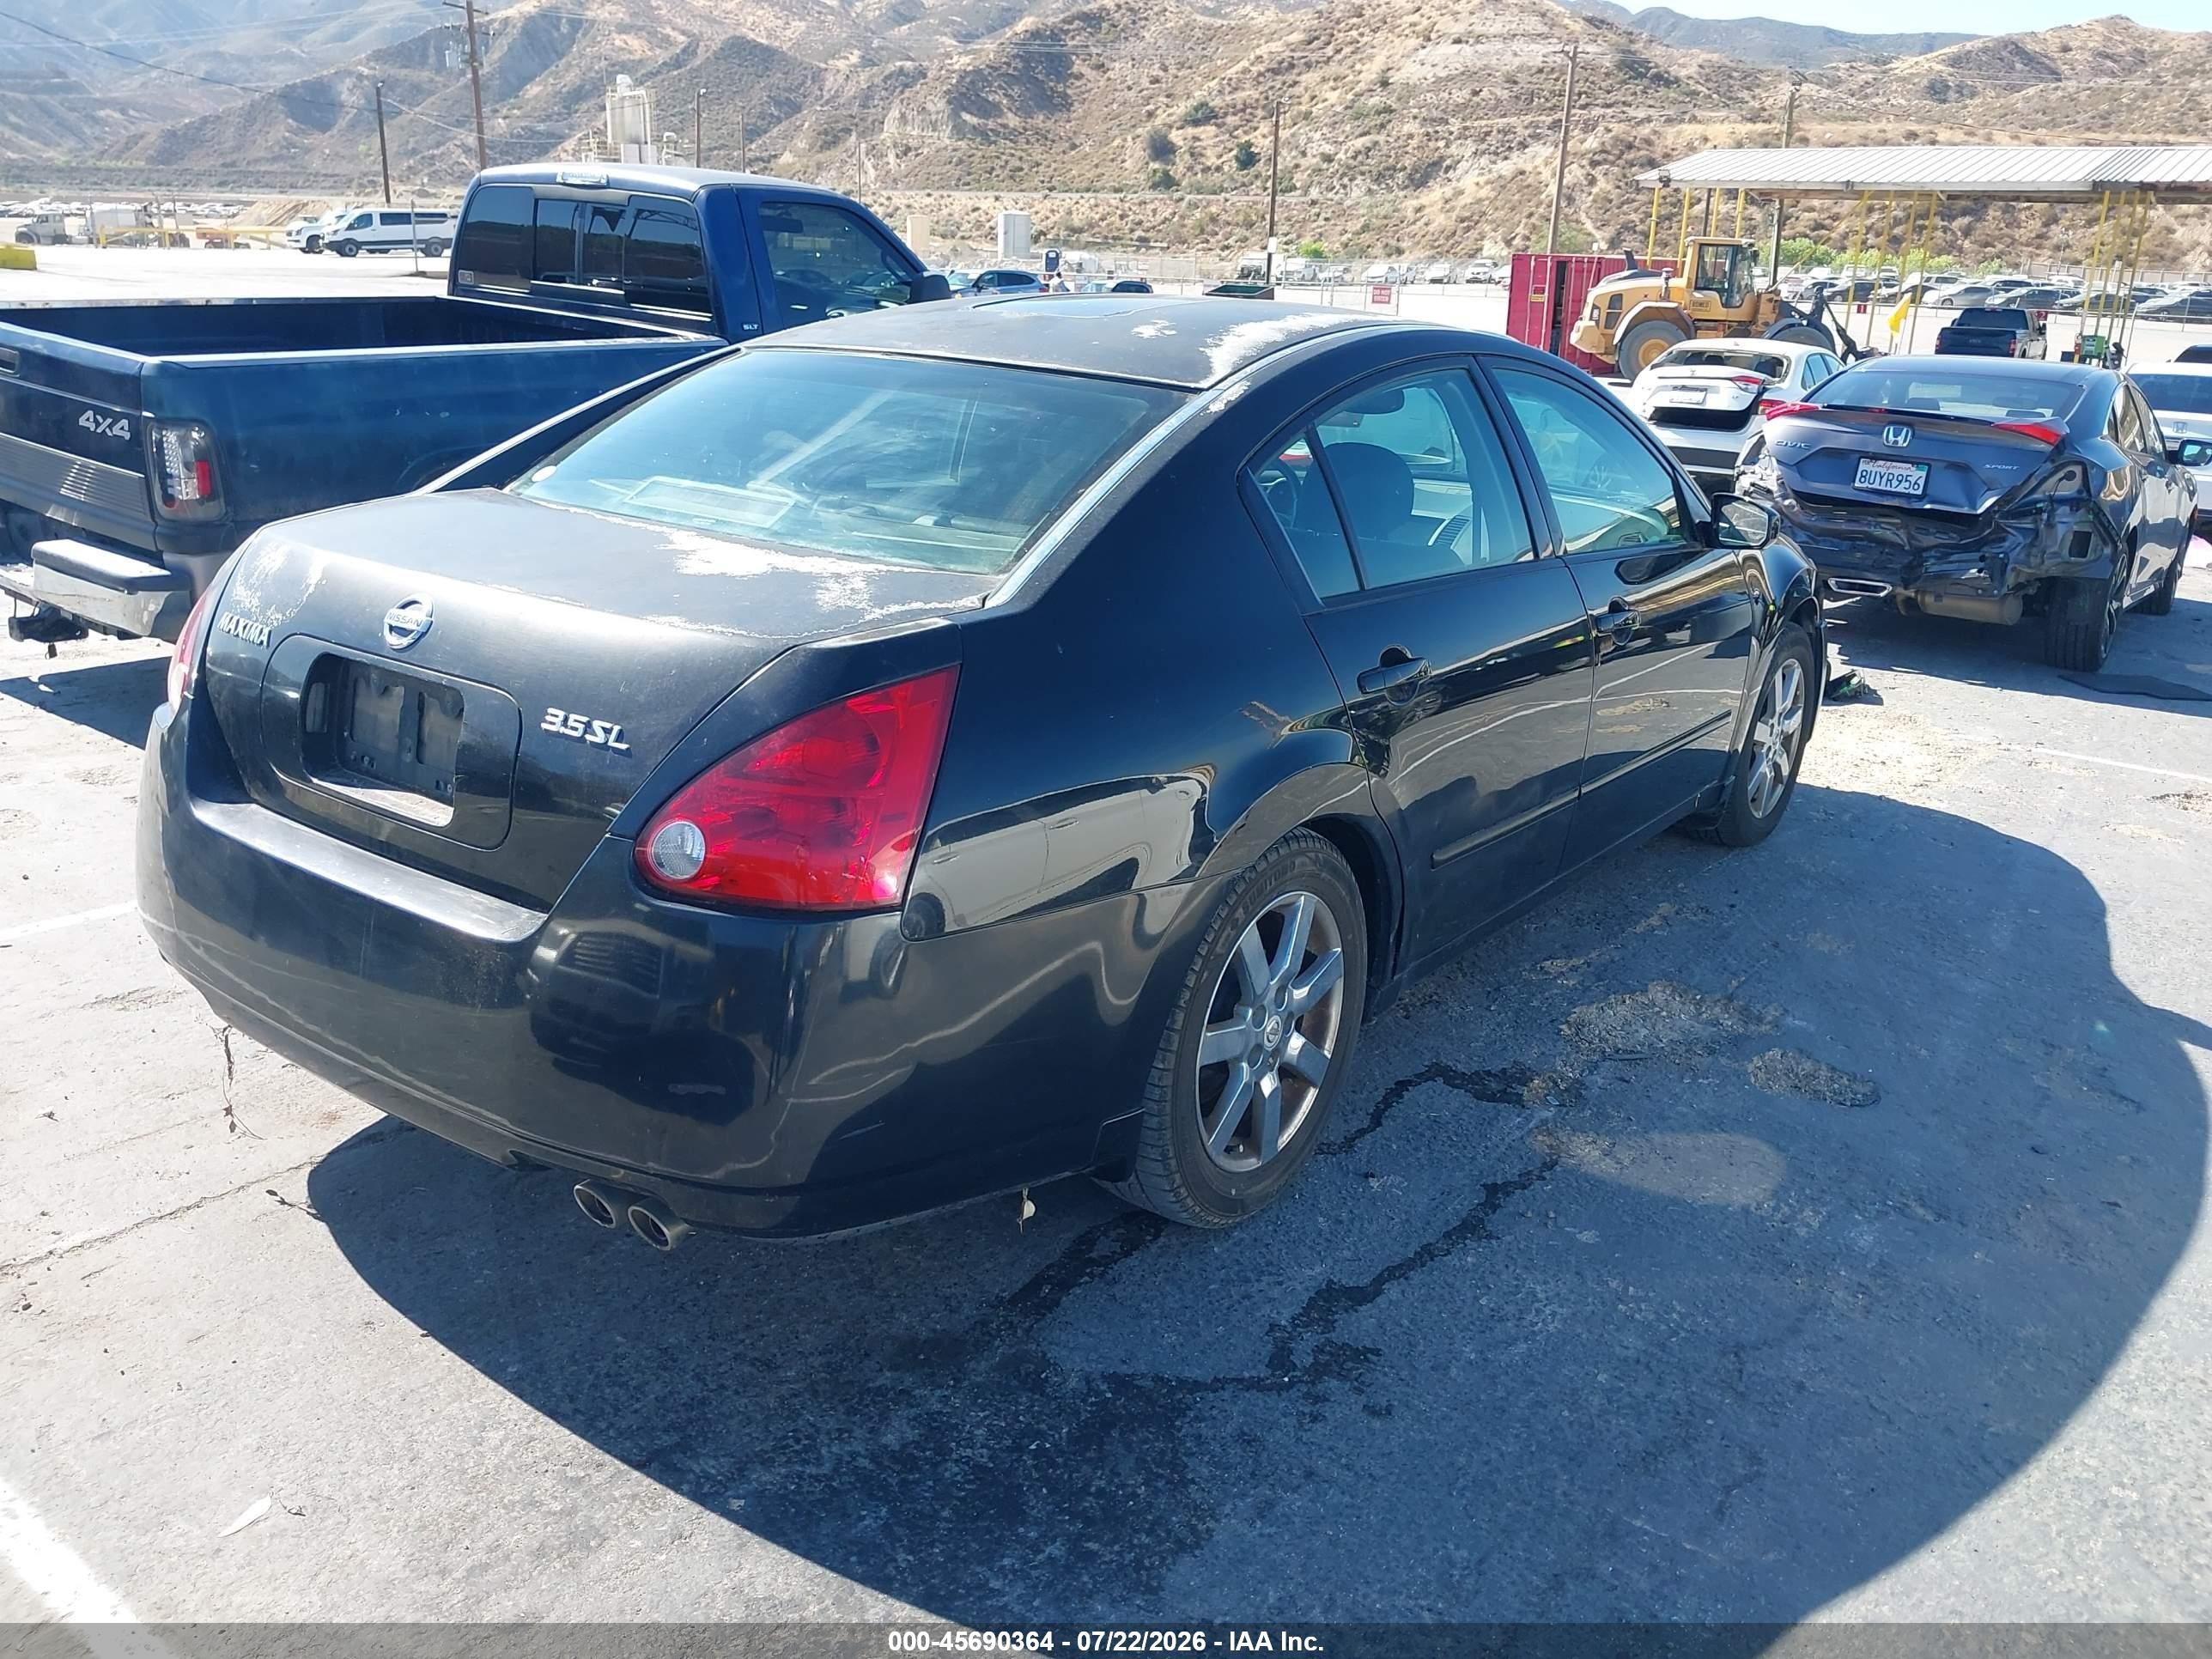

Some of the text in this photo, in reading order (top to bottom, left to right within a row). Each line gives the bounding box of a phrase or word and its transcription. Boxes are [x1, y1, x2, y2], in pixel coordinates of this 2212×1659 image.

[1774, 440, 1811, 449] CIVIC
[1871, 460, 1912, 471] California
[1858, 469, 1923, 491] 8UYR956
[387, 611, 423, 627] NISSAN
[216, 611, 271, 647] MAXIMA
